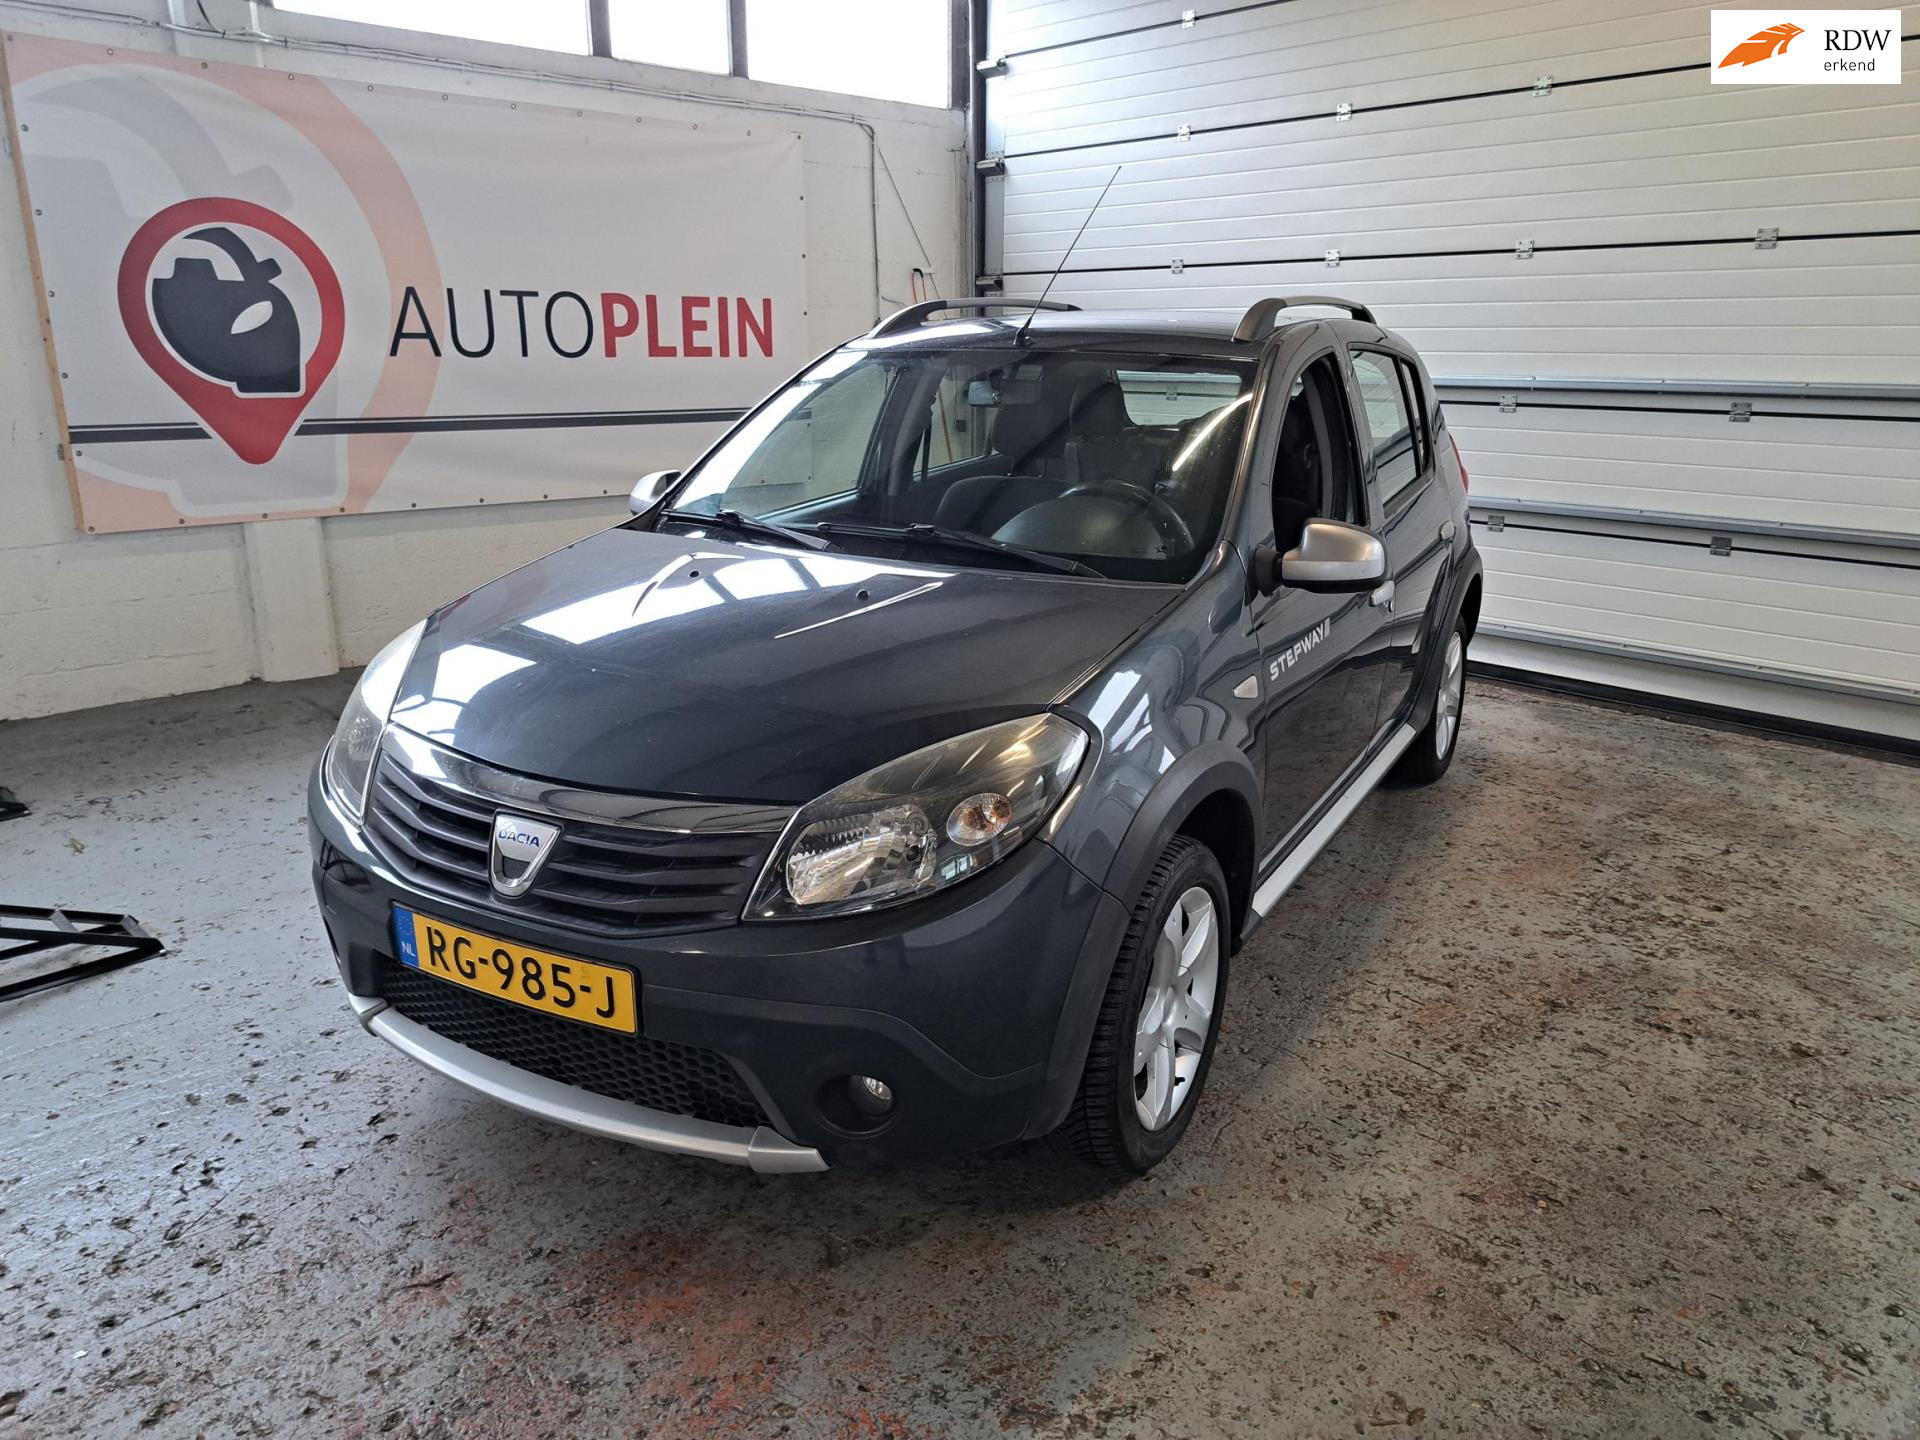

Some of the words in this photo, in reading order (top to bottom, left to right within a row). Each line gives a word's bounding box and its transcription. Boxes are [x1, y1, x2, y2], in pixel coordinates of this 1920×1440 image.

[389, 286, 773, 358] AUTOPLEIN
[1269, 621, 1324, 681] STEPWAY
[498, 829, 540, 848] DACIA
[401, 941, 416, 958] NL
[426, 925, 616, 1018] RG-985-J
